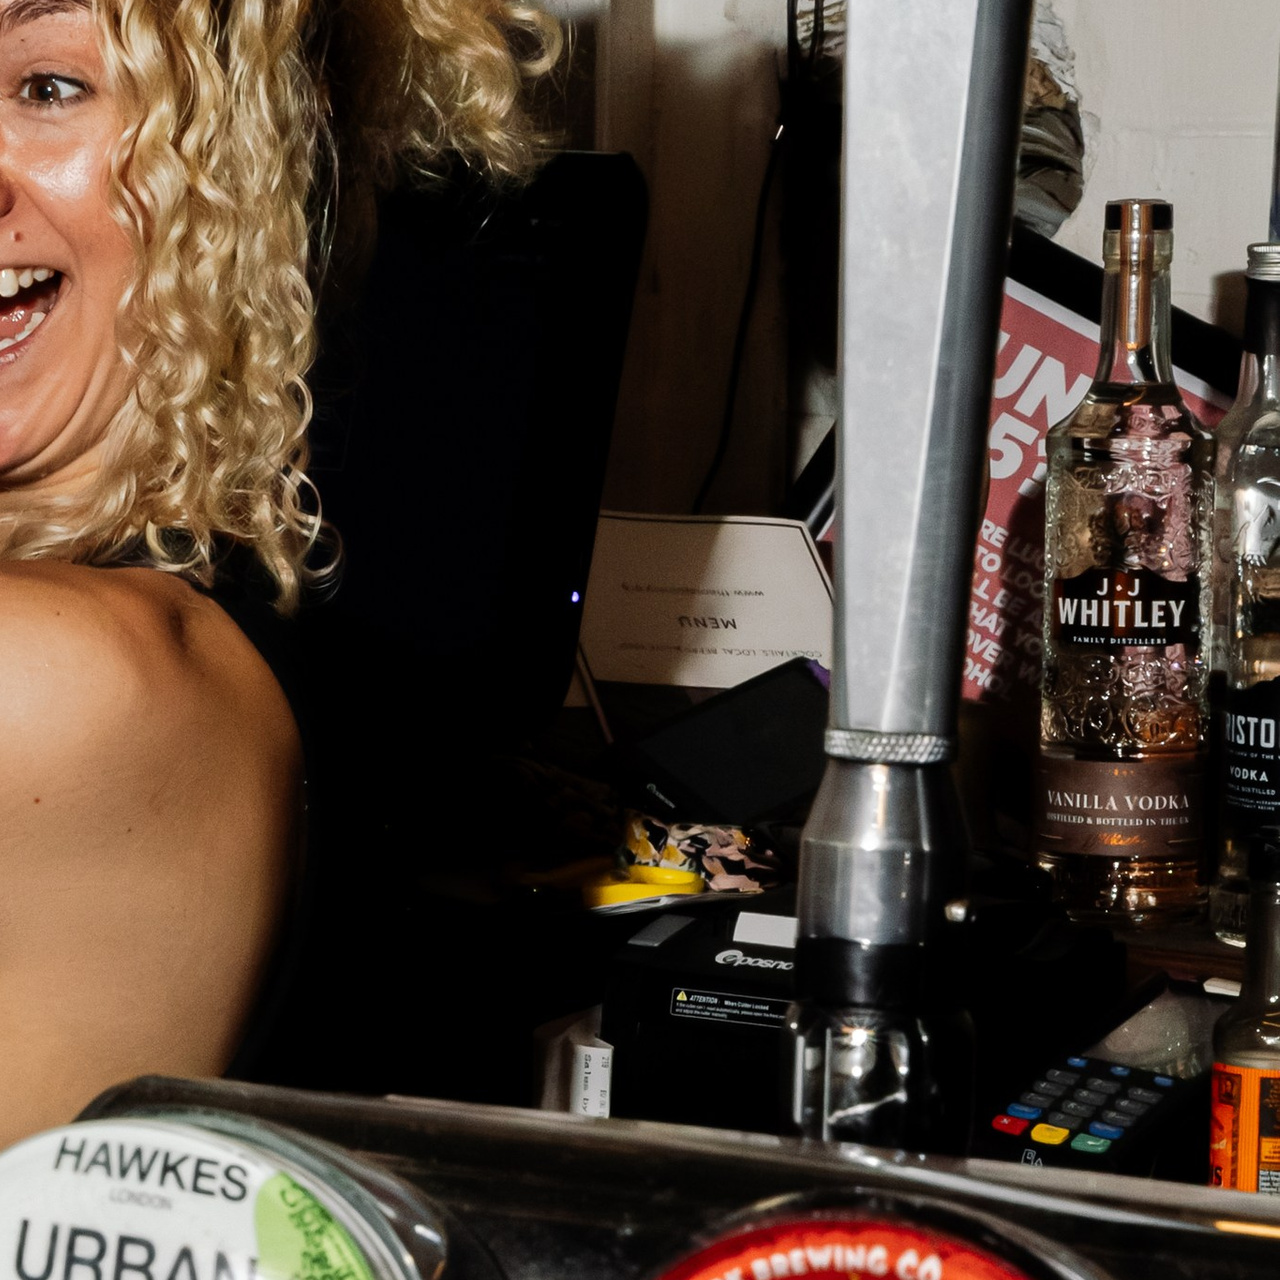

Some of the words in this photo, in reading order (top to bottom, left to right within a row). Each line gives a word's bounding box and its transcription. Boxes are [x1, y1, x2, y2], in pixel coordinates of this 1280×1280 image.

[677, 615, 738, 630] MENU
[1057, 597, 1186, 628] WHITLEY
[1073, 635, 1106, 645] FAMILY
[1110, 637, 1167, 645] DISTILLERS
[1229, 765, 1269, 783] VODKA
[1047, 789, 1119, 812] VANILLA
[1125, 794, 1190, 811] VODKA
[1095, 816, 1144, 827] BOTTLED
[1146, 817, 1157, 826] IN
[53, 1136, 251, 1203] HAWKES
[107, 1187, 175, 1212] LONDON
